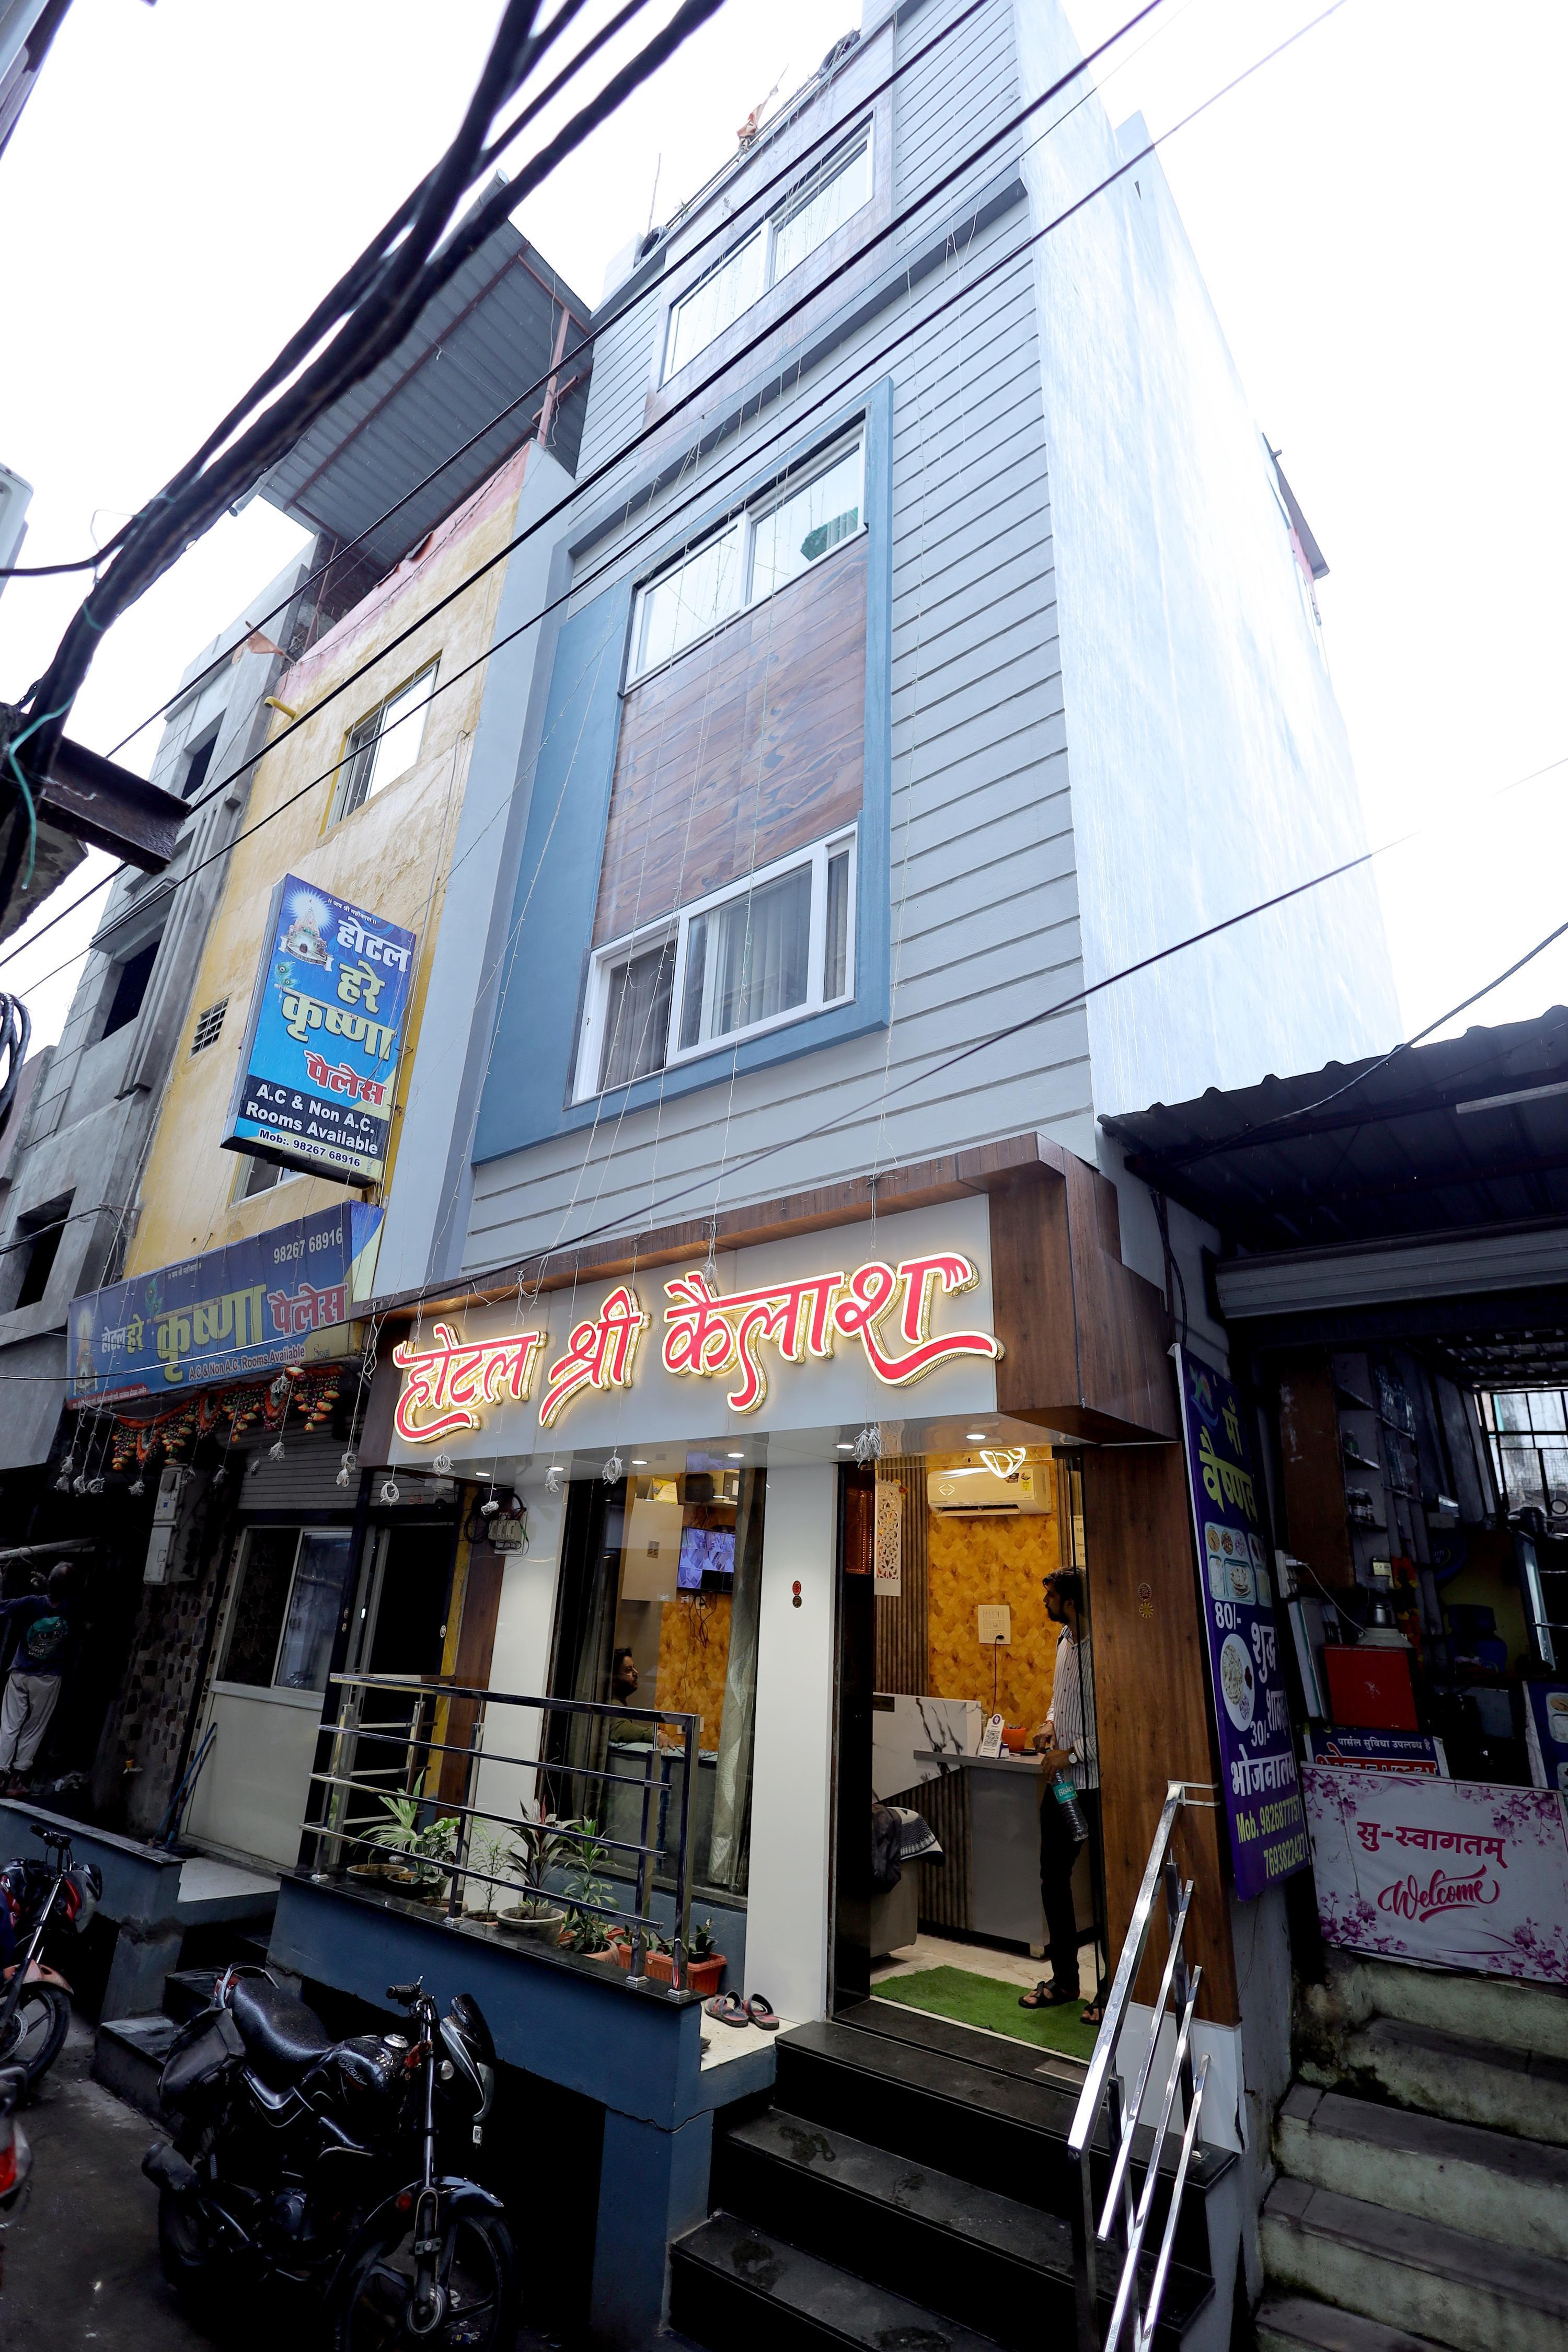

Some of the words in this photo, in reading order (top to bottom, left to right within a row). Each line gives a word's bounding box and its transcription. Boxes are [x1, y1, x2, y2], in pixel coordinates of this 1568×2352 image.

[337, 916, 411, 973] होटल
[337, 961, 386, 1013] हरे
[282, 993, 398, 1062] कृष्णा
[304, 1050, 388, 1106] पैलेस
[246, 1101, 303, 1132] Rooms
[306, 1125, 378, 1156] Available
[256, 1083, 287, 1104] A.C
[291, 1096, 304, 1110] &
[308, 1099, 340, 1123] Non
[344, 1114, 375, 1134] A.C.
[293, 1138, 326, 1157] 98267
[328, 1149, 361, 1168] 68916
[273, 1239, 305, 1264] 98267
[308, 1227, 343, 1253] 68916
[101, 1326, 126, 1353] होटल
[127, 1313, 145, 1354] हरे
[156, 1283, 267, 1383] कृष्णा
[267, 1282, 349, 1336] पैलेस
[392, 1322, 547, 1443] होटल
[538, 1284, 651, 1428] श्री
[662, 1250, 1006, 1415] कैलाश
[189, 1365, 202, 1381] A.C
[202, 1366, 209, 1377] &
[209, 1362, 224, 1377] Non
[225, 1357, 240, 1373] A.C.
[241, 1354, 268, 1368] Rooms
[268, 1344, 306, 1365] Available
[1215, 1601, 1241, 1630] 80/-
[1251, 1621, 1276, 1684] शुद्ध
[1250, 1720, 1270, 1747] 30/-
[1363, 1736, 1390, 1750] सुविधा
[1424, 1738, 1431, 1751] है
[1230, 1744, 1296, 1797] भोजनालय
[1236, 1810, 1259, 1844] Mob.
[1356, 1820, 1508, 1869] सु-स्वागतम्
[1377, 1863, 1502, 1920] Welcome
